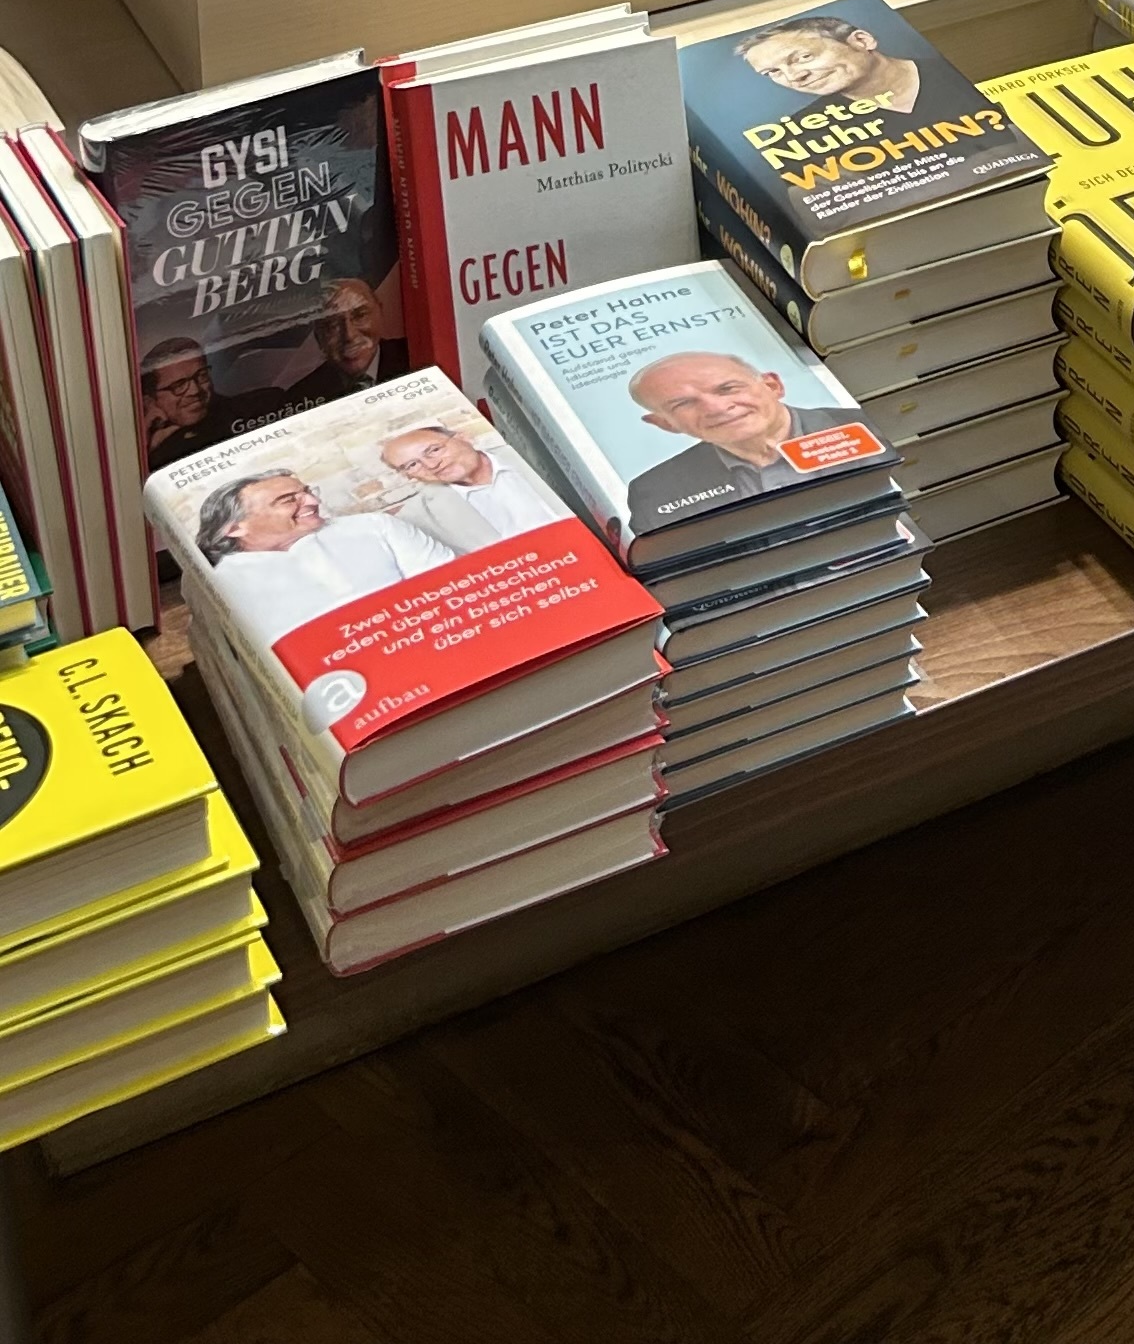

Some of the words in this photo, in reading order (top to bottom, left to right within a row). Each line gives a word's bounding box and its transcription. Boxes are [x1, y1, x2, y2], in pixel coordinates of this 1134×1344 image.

[1028, 63, 1091, 87] PÖRKSEN
[447, 82, 607, 181] MANN
[743, 90, 895, 150] Dieter
[760, 116, 885, 170] Nuhr
[200, 127, 291, 190] GYSI
[780, 109, 1005, 191] WOHIN?
[166, 162, 331, 240] GEGEN
[537, 173, 604, 195] Matthias
[1078, 171, 1113, 190] SICH
[151, 193, 359, 291] GUTTEN
[191, 246, 326, 318] BERG
[459, 240, 570, 306] GEGEN
[530, 308, 599, 336] Peter
[607, 287, 693, 312] Hahne
[540, 327, 580, 351] IST
[593, 311, 650, 336] DAS
[550, 336, 625, 366] EUER
[364, 375, 432, 406] GREGOR
[402, 383, 439, 401] GYSI
[167, 428, 292, 482] PETER-MICHAEL
[175, 459, 236, 490] DIESTEL
[657, 482, 736, 514] QUADRIGA
[322, 630, 390, 666] reden
[392, 606, 440, 634] über
[442, 552, 579, 620] Deutschland
[338, 614, 392, 639] Zwei
[394, 549, 540, 612] Unbelehrbare
[382, 634, 424, 656] und
[428, 619, 464, 640] ein
[468, 575, 562, 620] bisschen
[433, 627, 486, 653] über
[488, 610, 533, 631] sich
[536, 576, 599, 612] selbst
[352, 681, 432, 730] aufbau
[78, 693, 154, 777] SKACH
